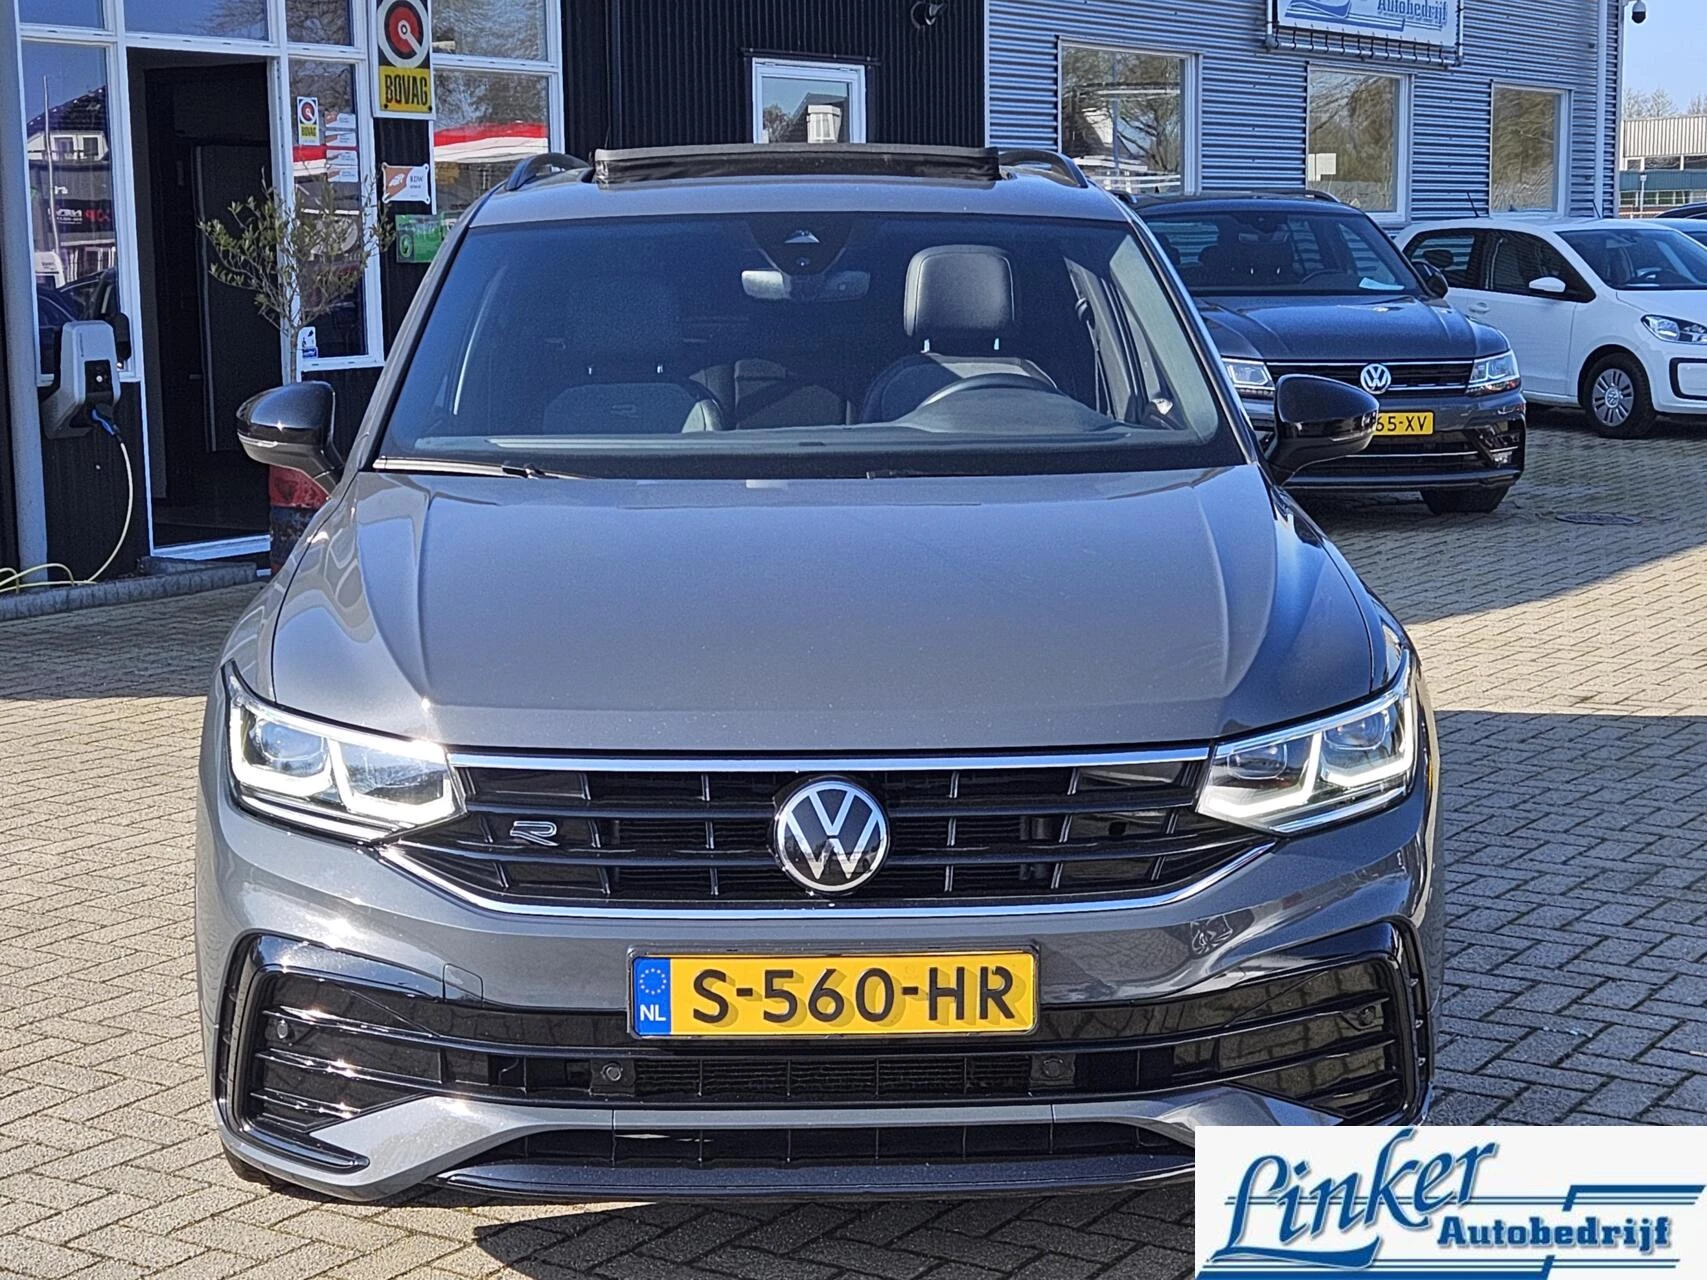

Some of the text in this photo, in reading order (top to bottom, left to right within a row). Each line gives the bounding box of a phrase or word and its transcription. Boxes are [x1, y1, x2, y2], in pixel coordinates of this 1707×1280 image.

[384, 74, 428, 106] BOVAG
[640, 966, 1015, 1024] NL S-560-HR
